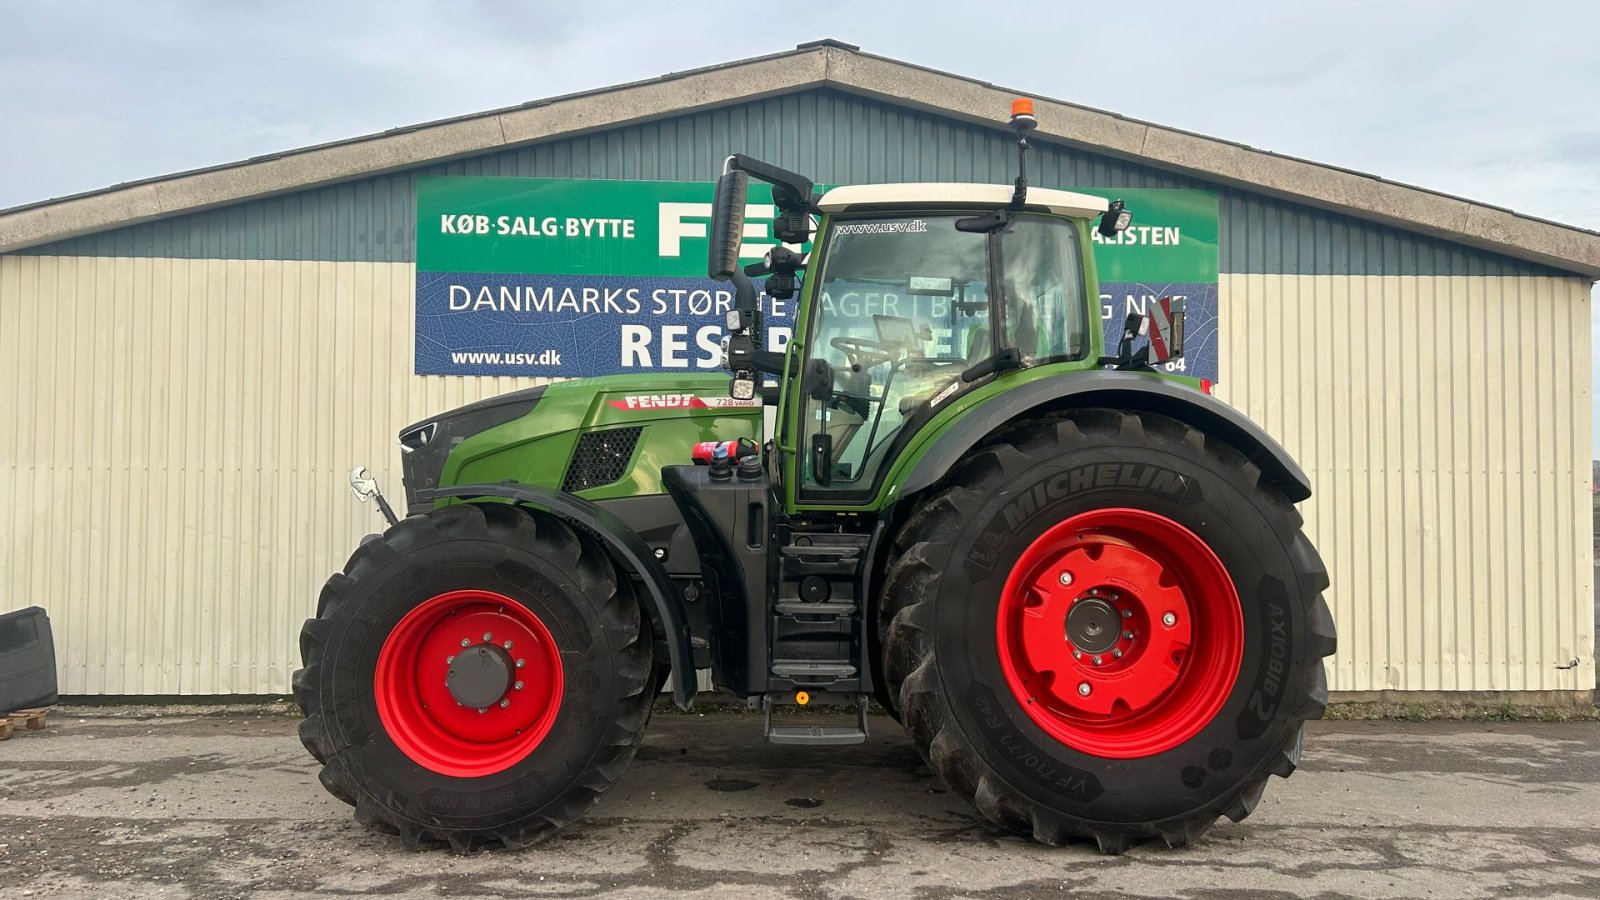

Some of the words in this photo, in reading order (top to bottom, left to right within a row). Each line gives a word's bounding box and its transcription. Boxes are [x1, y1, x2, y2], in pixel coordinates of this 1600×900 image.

[837, 220, 928, 234] www.usv.dk
[1090, 226, 1180, 246] ALISTEN
[449, 284, 641, 314] DANMARKS
[821, 291, 900, 318] AGER
[451, 350, 562, 366] www.usv.dk
[625, 393, 695, 409] FENDT
[716, 398, 733, 406] 728
[1002, 464, 1184, 530] MICHELIN
[1263, 602, 1286, 696] AXIOBIB
[1248, 689, 1275, 721] 2
